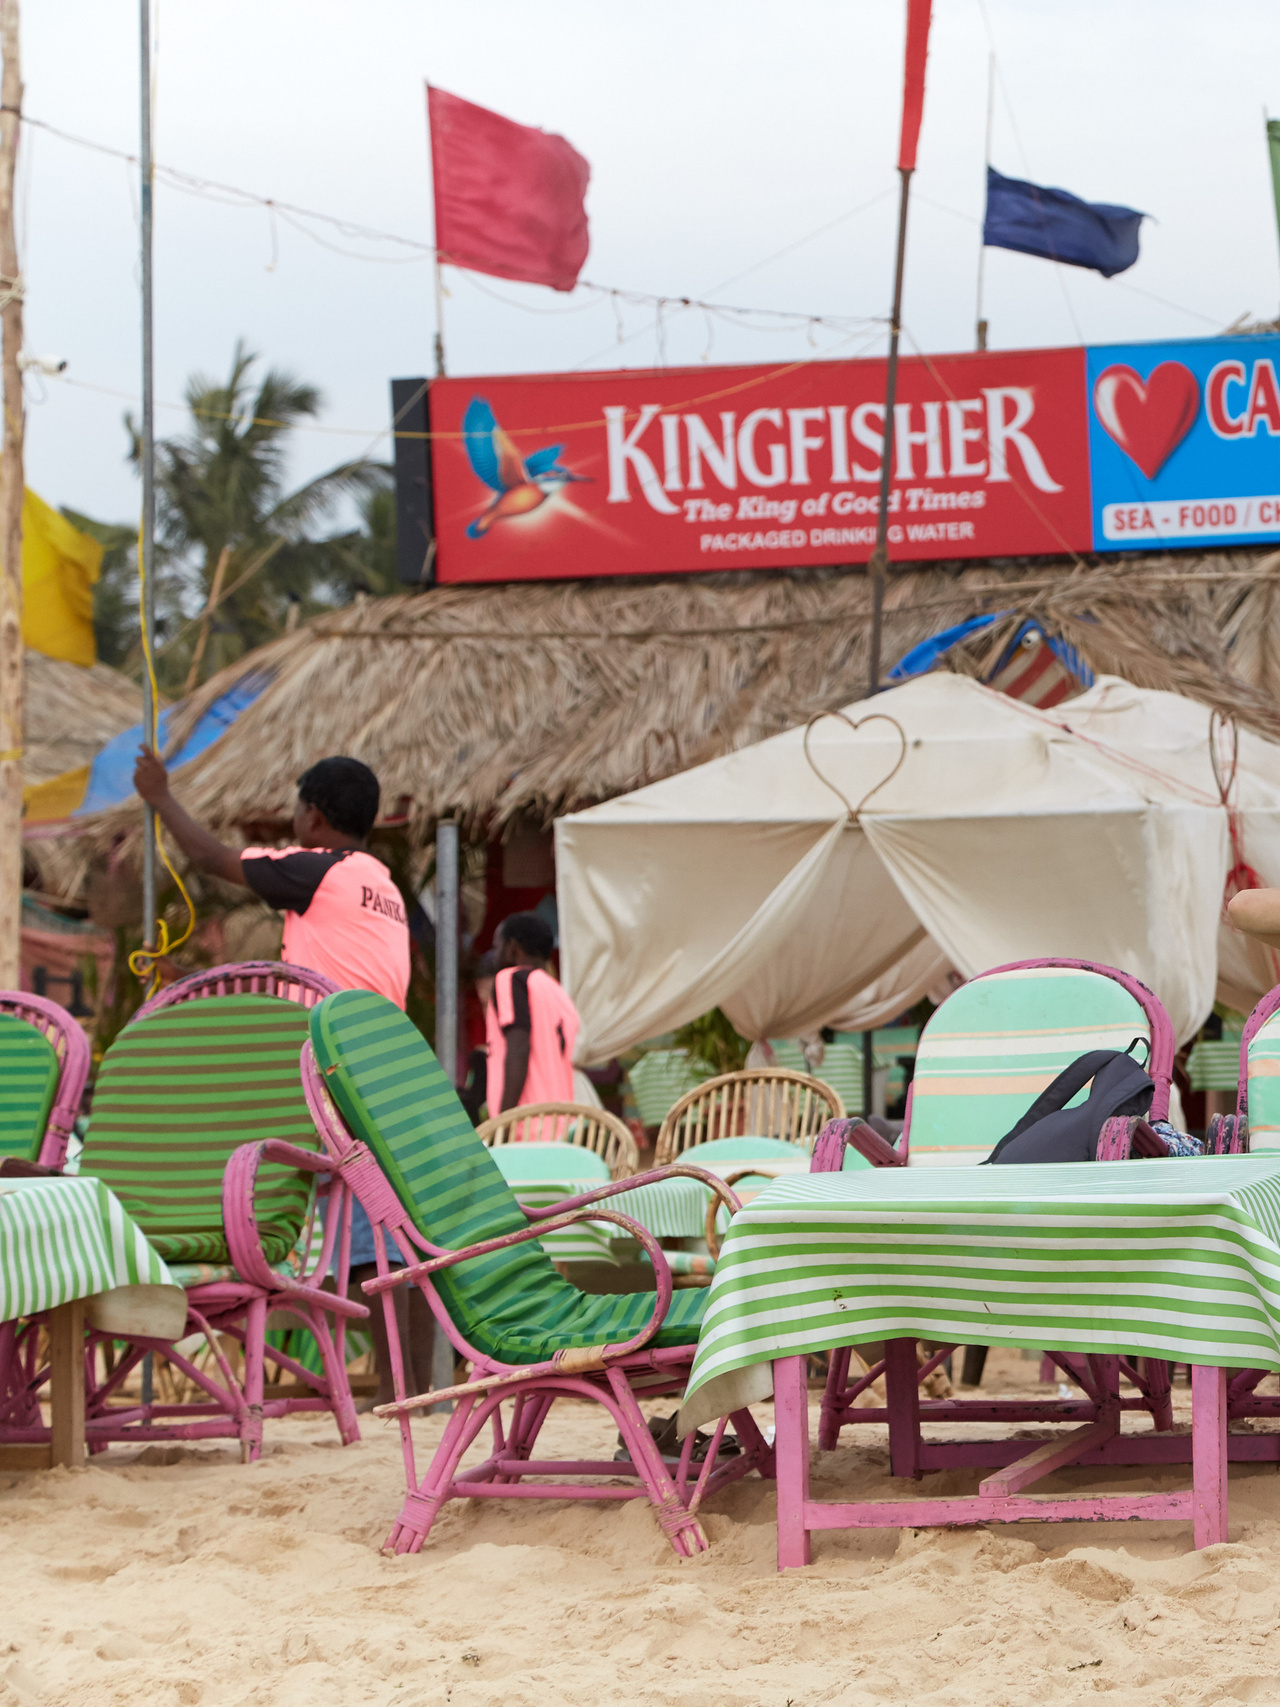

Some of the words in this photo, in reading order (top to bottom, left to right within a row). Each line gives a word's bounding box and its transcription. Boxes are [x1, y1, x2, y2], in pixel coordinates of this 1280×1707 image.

[601, 386, 1064, 514] KINGFISHER
[684, 498, 733, 523] The
[737, 494, 798, 524] King
[801, 492, 829, 517] of
[832, 489, 901, 515] Good
[905, 486, 986, 511] Times
[1113, 508, 1154, 532] SEA
[1179, 504, 1237, 528] FOOD
[700, 529, 807, 552] PACKAGED
[810, 525, 905, 547] DRINKIG
[906, 521, 976, 542] WATER
